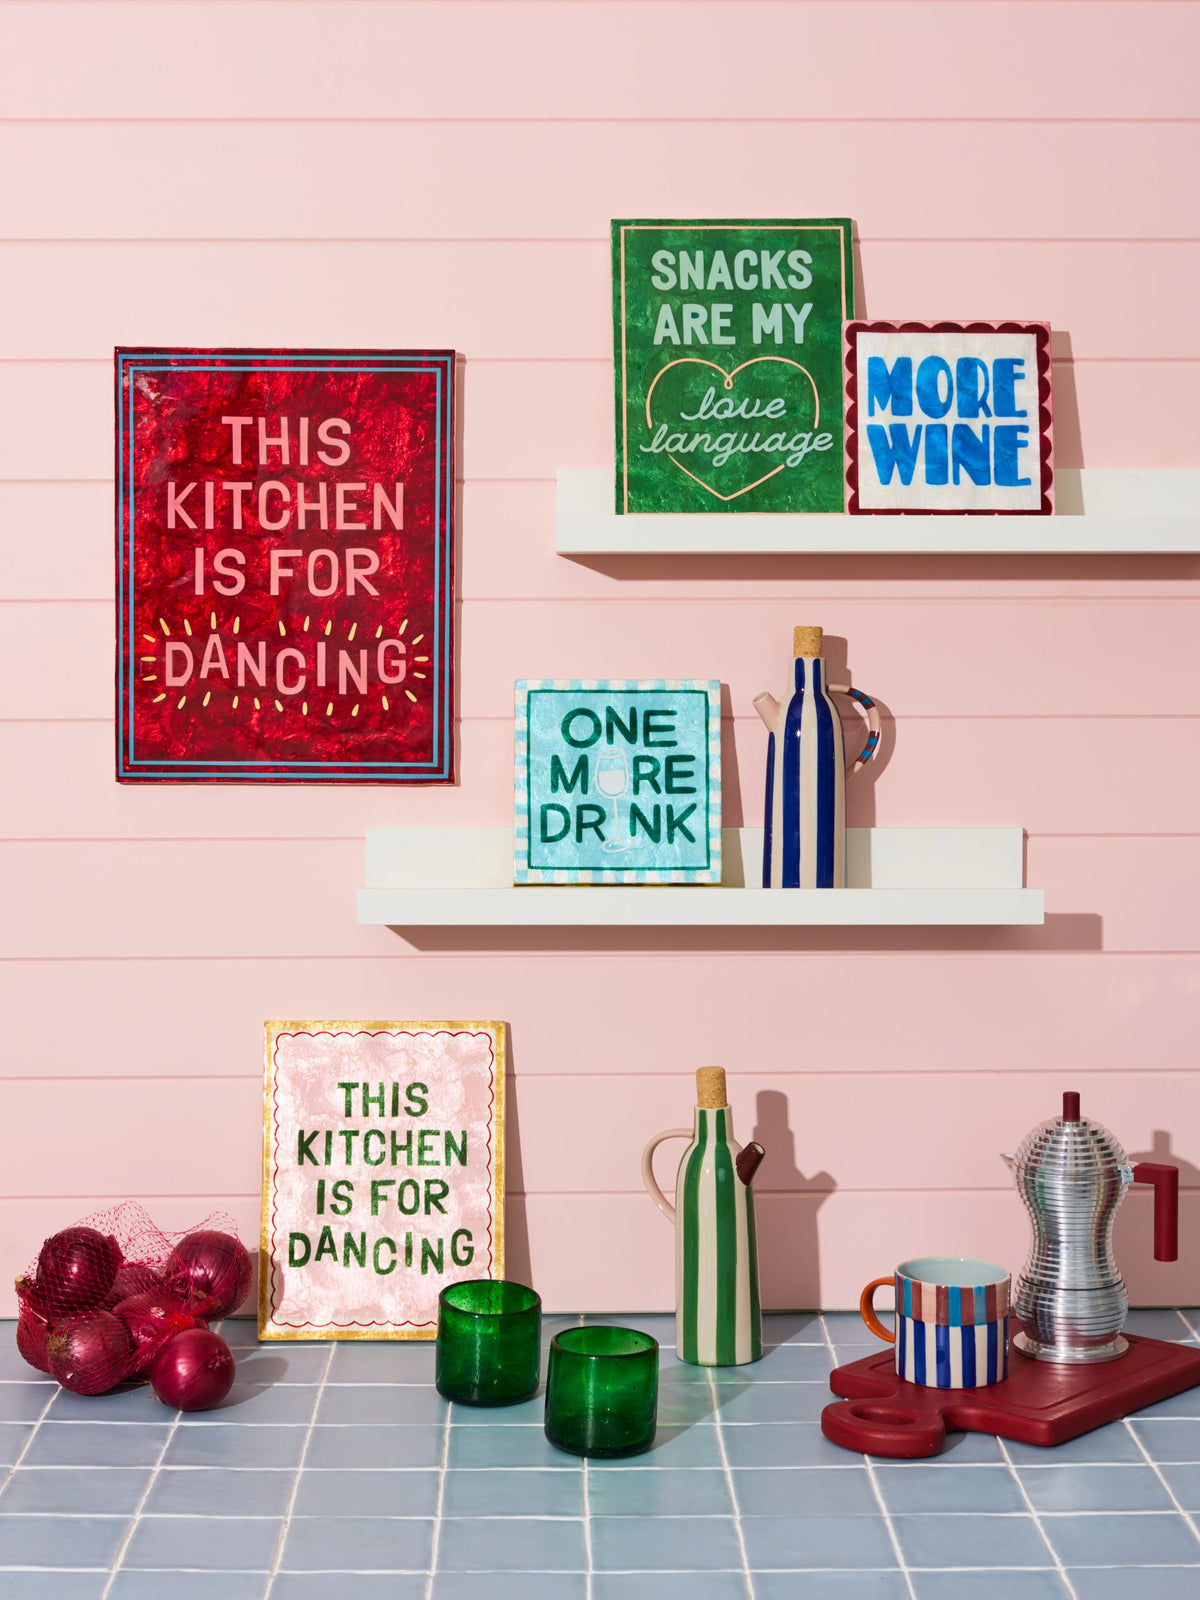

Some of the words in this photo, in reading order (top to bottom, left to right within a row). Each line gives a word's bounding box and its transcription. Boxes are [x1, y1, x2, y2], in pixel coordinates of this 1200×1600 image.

[651, 249, 813, 291] SNACKS
[653, 303, 736, 345] ARE
[752, 303, 813, 345] MY
[680, 386, 786, 422] love
[867, 356, 1028, 419] MORE
[221, 416, 351, 466] THIS
[639, 424, 834, 468] language
[867, 424, 1032, 487] WINE
[167, 480, 404, 531] KITCHEN
[194, 547, 246, 596] IS
[269, 547, 380, 597] FOR
[164, 633, 407, 696] DANCING
[561, 706, 678, 749] ONE
[337, 1082, 429, 1118] THIS
[297, 1129, 467, 1167] KITCHEN
[316, 1179, 354, 1215] IS
[370, 1178, 450, 1216] FOR
[288, 1225, 475, 1276] DANCING
